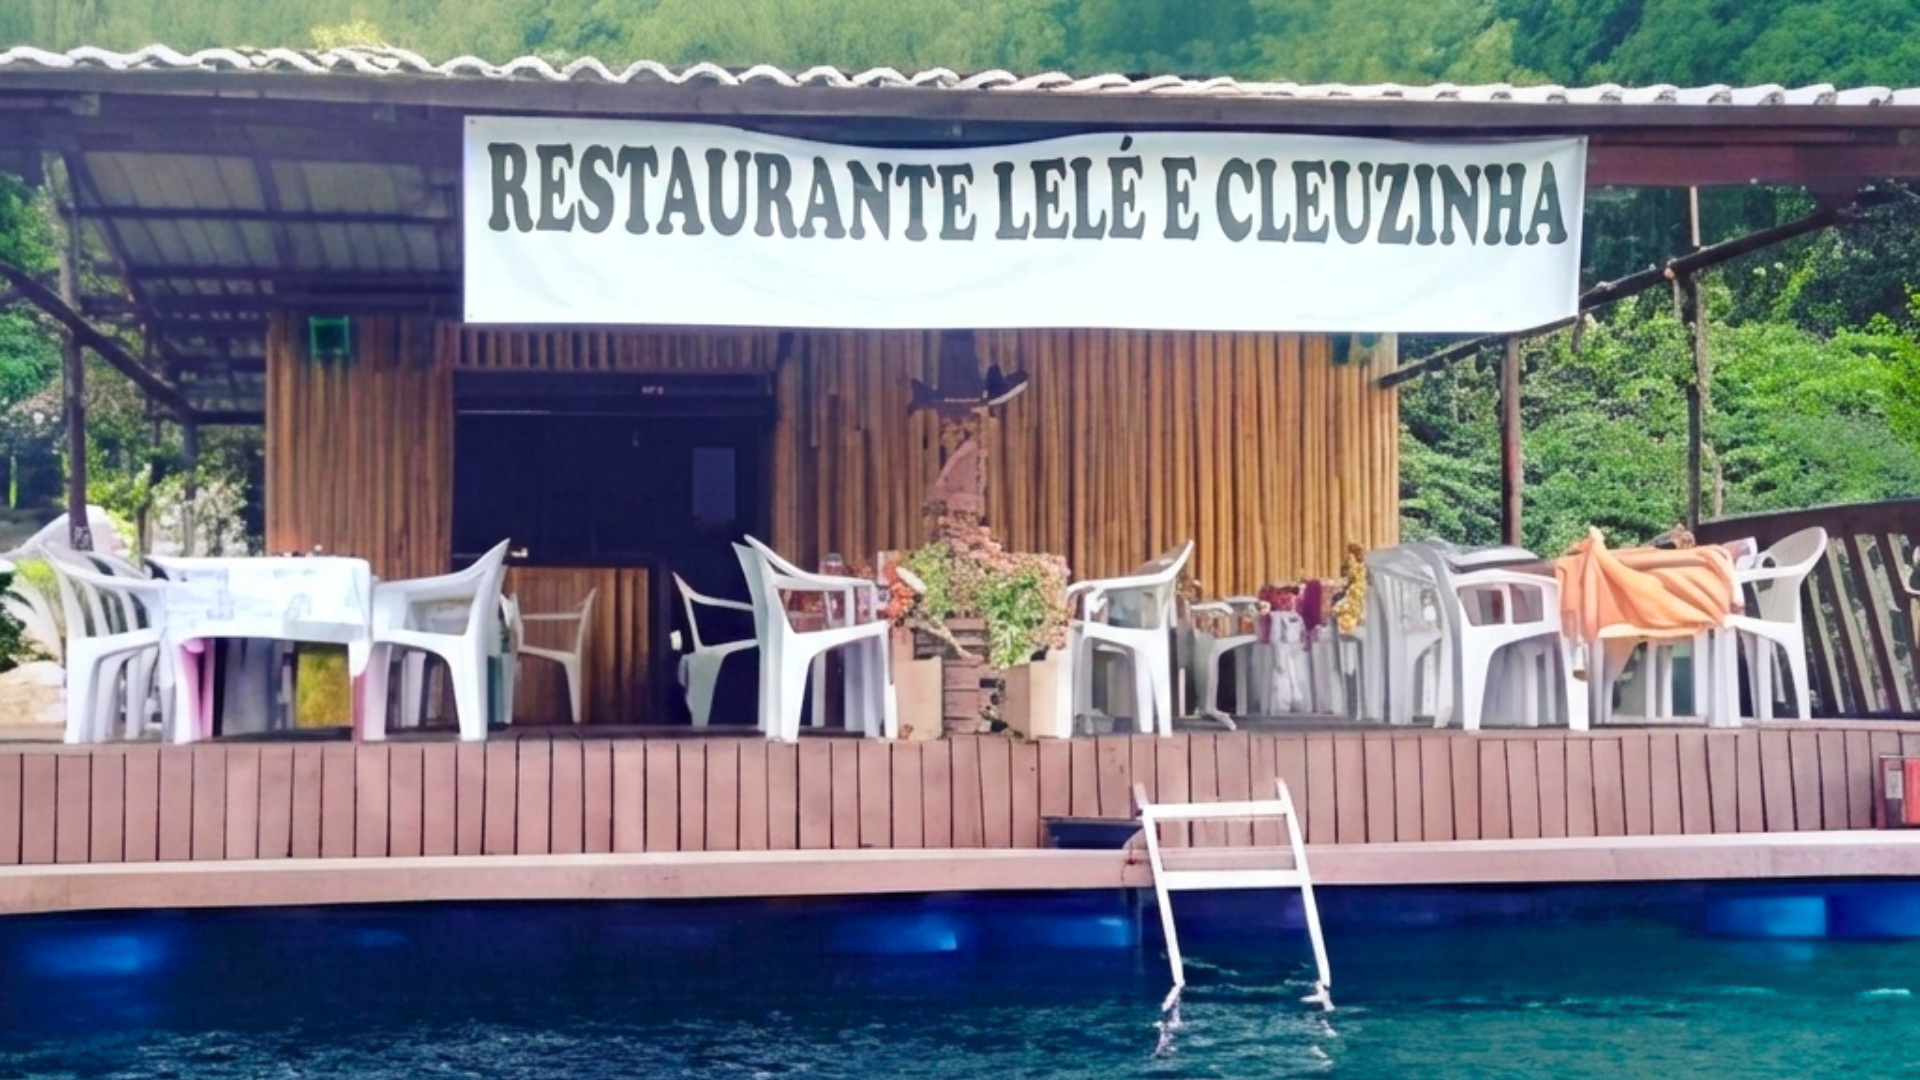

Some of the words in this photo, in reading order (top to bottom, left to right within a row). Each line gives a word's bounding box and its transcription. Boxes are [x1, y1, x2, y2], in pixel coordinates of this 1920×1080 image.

[488, 142, 976, 241] RESTAURANTE
[994, 135, 1145, 241] LELÉ
[1162, 156, 1199, 241] E
[1216, 157, 1568, 246] CLEUZINHA
